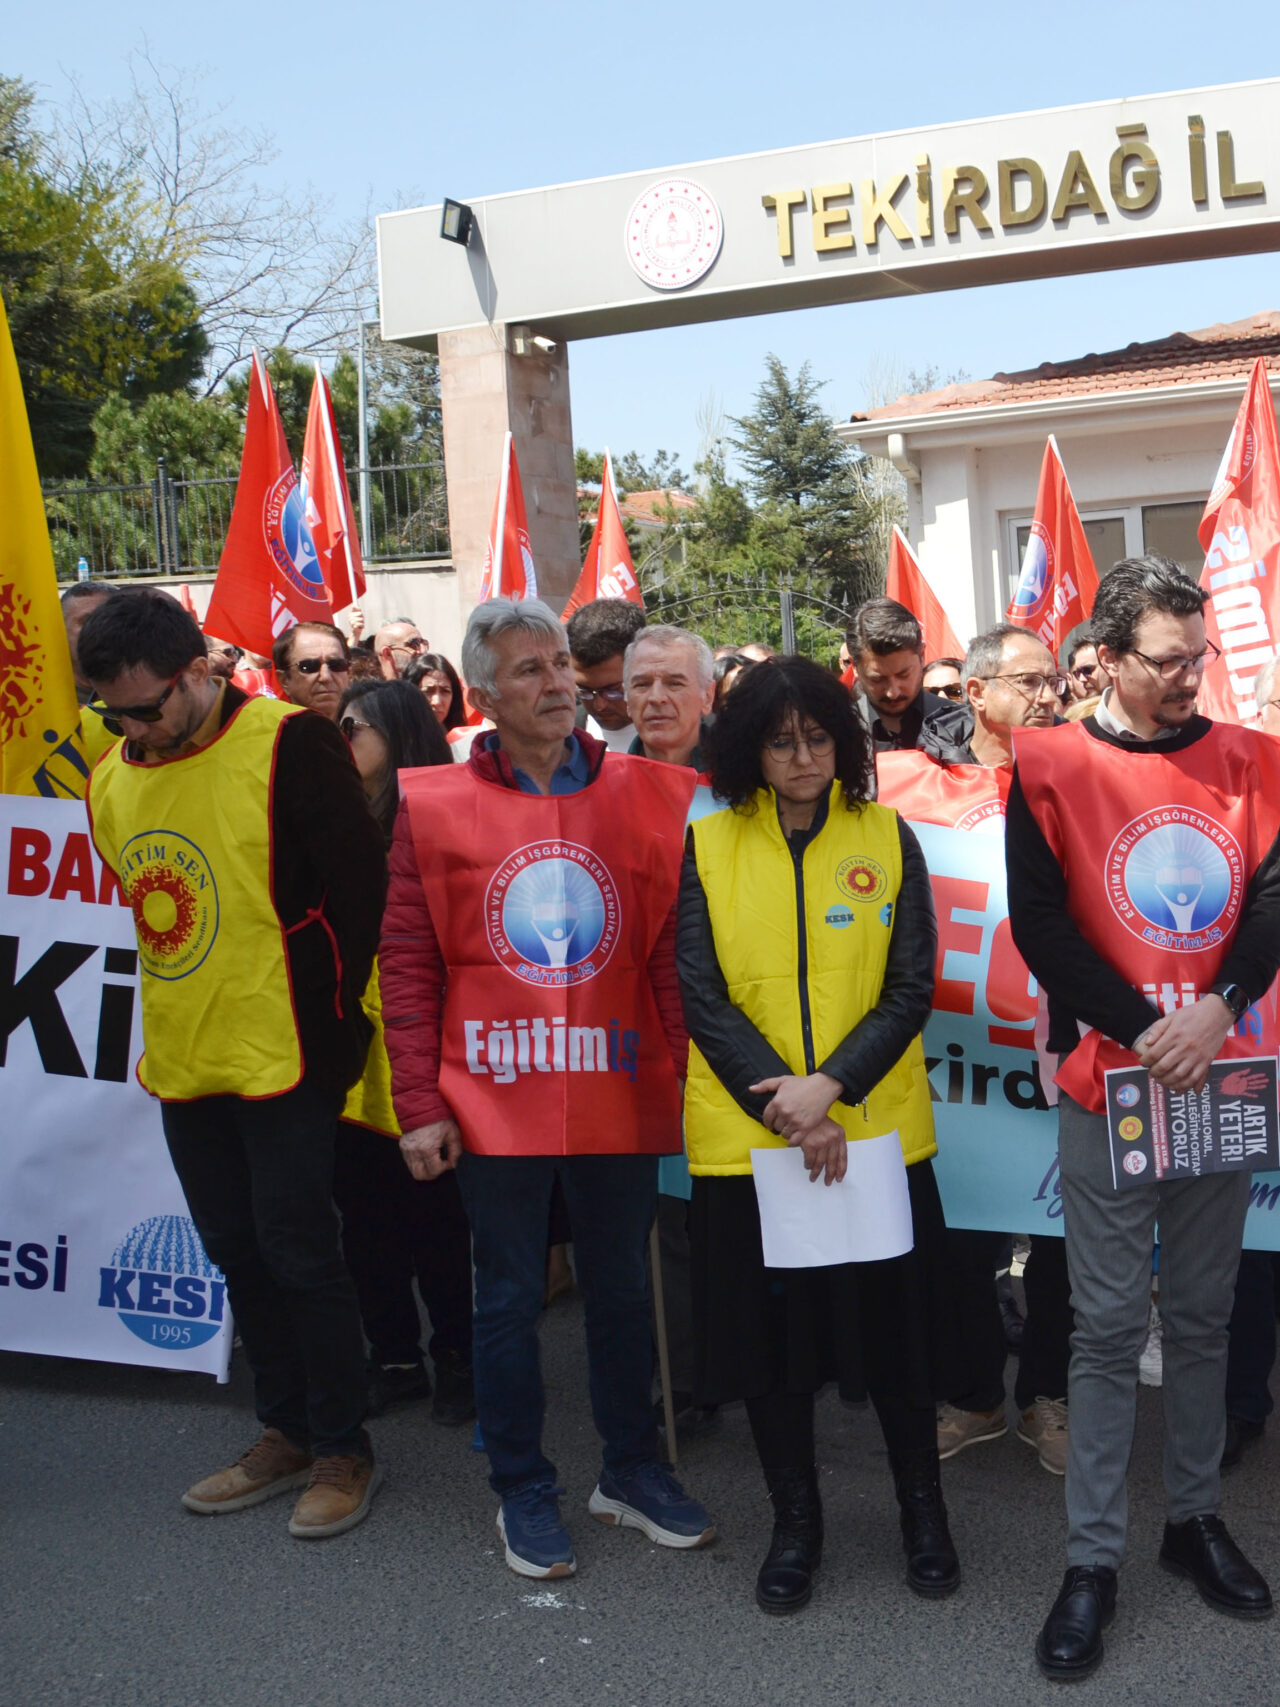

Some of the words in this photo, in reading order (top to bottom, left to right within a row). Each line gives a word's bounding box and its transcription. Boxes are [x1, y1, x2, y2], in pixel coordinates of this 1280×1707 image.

[762, 122, 1159, 258] TEKİRDAĞ
[1187, 115, 1265, 203] İL
[1118, 821, 1148, 853] BİLİM
[1147, 808, 1232, 848] İŞGÖRENLERİ
[173, 850, 209, 891] SEN
[497, 855, 527, 887] BİLİM
[527, 843, 608, 883] İŞGÖRENLERİ
[1111, 853, 1124, 870] VE
[491, 889, 503, 906] VE
[1111, 873, 1136, 919] EĞİTİM
[1225, 847, 1242, 919] SENDİKASI
[490, 909, 510, 956] EĞİTİM
[599, 884, 618, 954] SENDİKASI
[825, 913, 855, 924] KESK
[1142, 925, 1223, 950] EĞİTİM-İŞ
[515, 961, 596, 984] EĞİTİM-İŞ
[1188, 1107, 1201, 1141] EĞİTİM
[1202, 1122, 1214, 1158] OKUL,
[1218, 1099, 1244, 1163] YETER!
[1243, 1103, 1268, 1157] ARTIK
[151, 1322, 191, 1345] 1995
